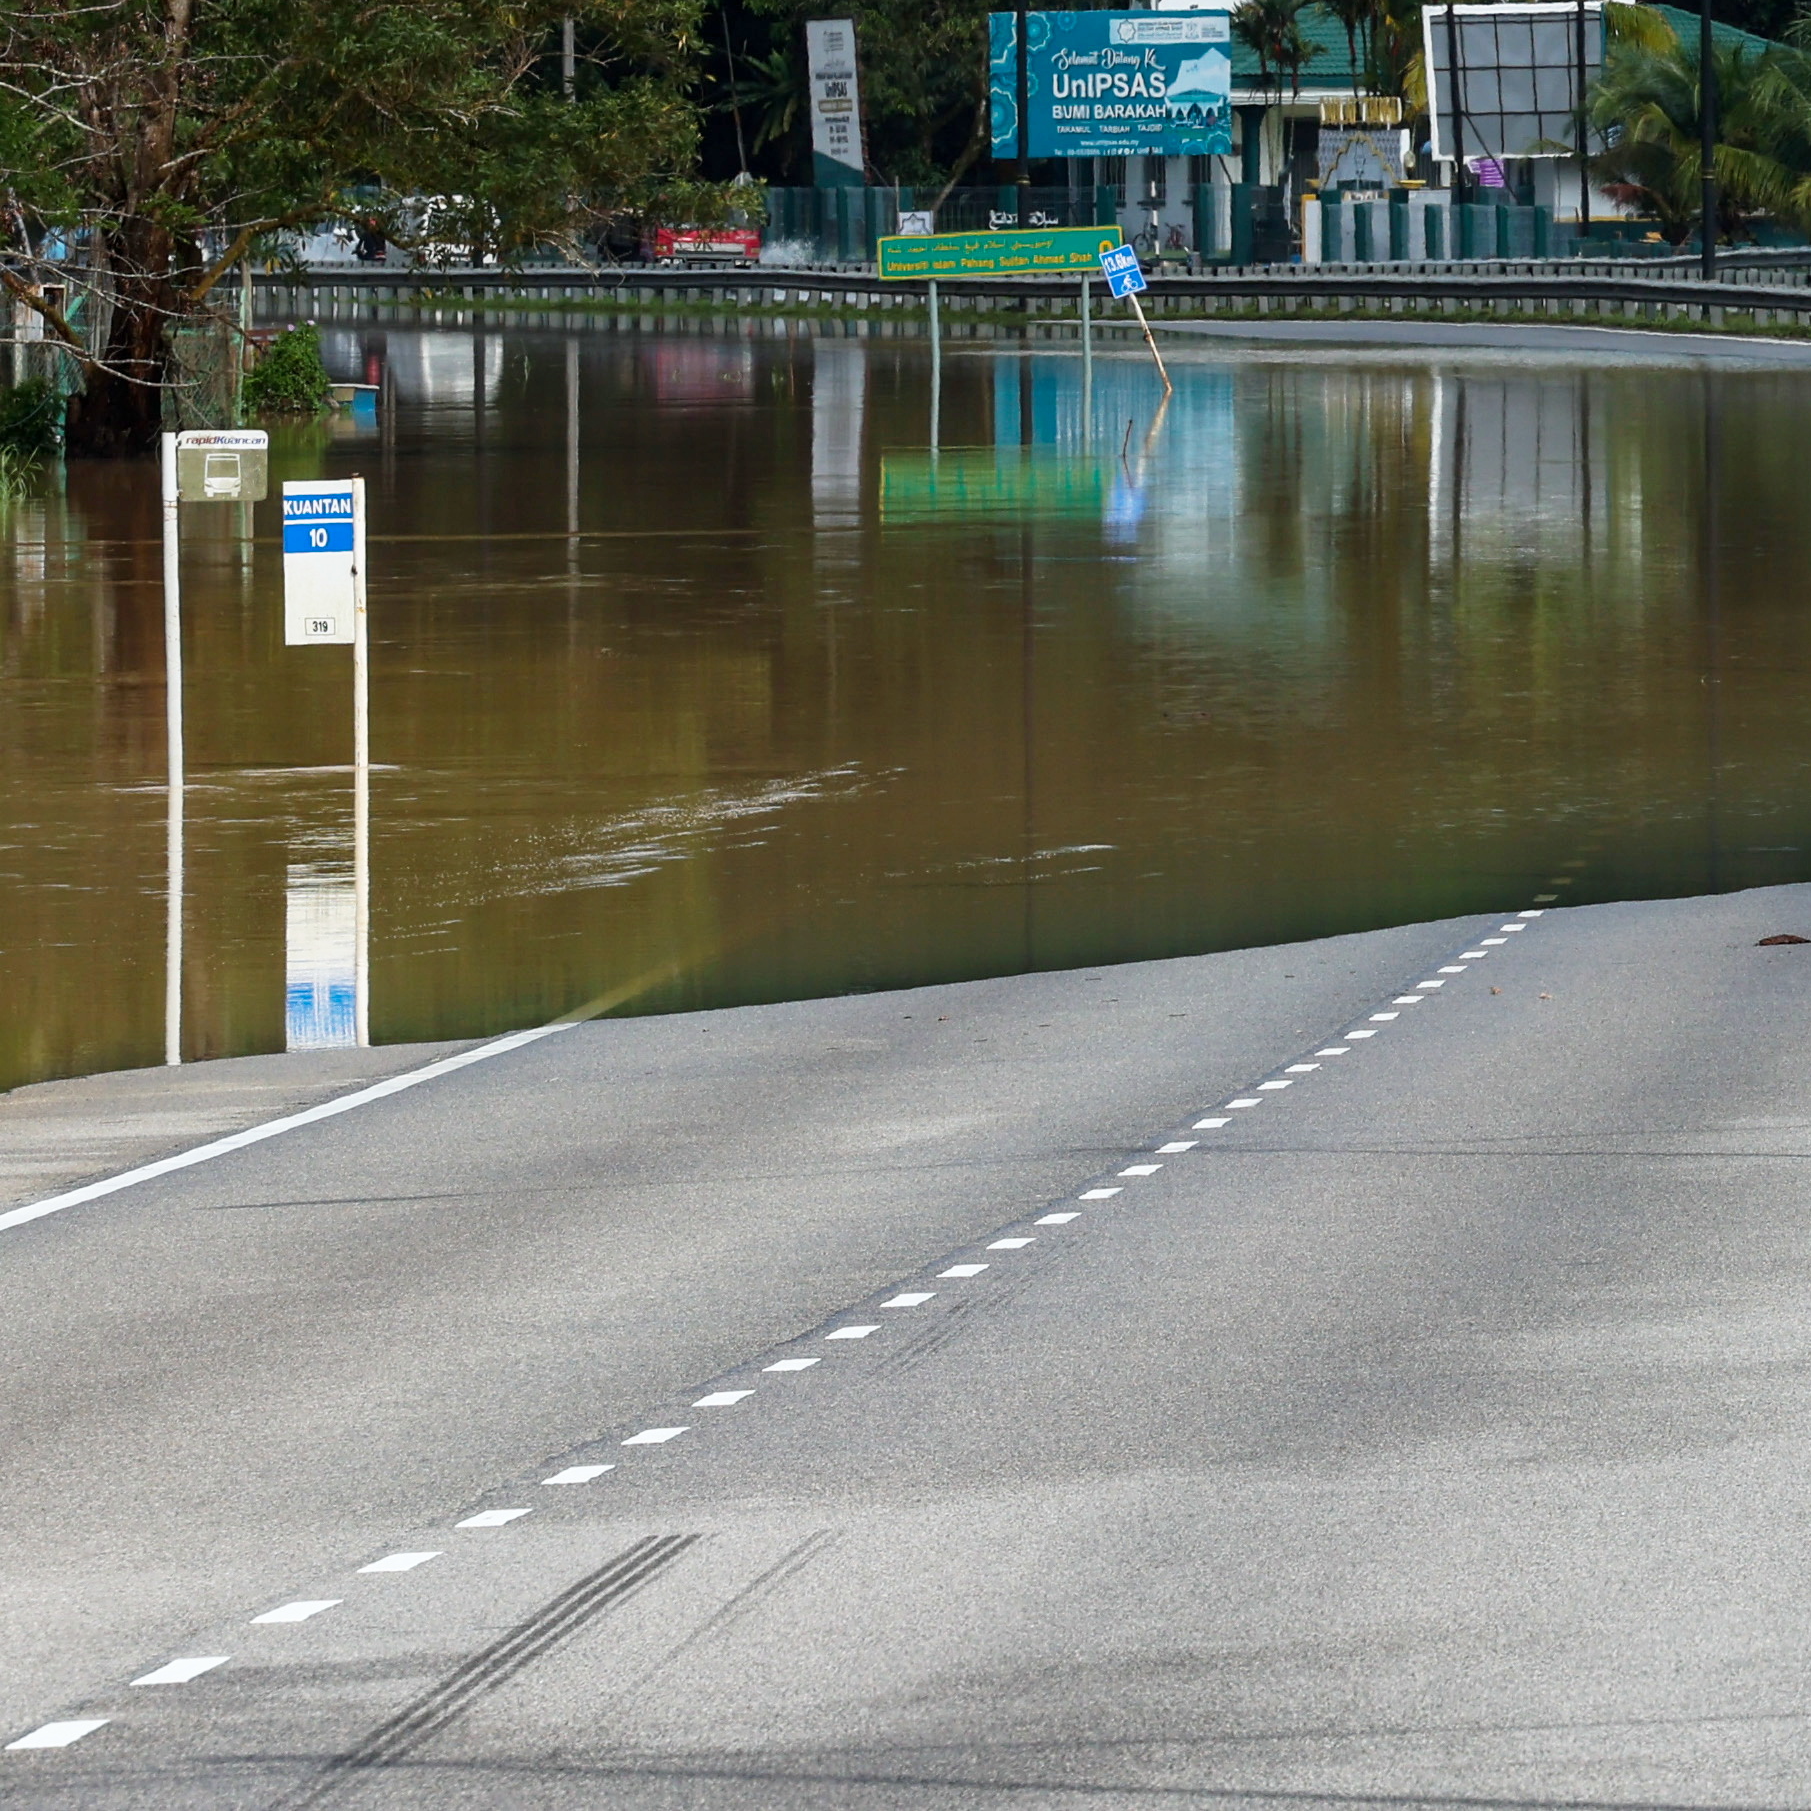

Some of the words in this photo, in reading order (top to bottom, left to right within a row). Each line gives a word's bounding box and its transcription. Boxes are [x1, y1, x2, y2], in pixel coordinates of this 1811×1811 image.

[1051, 48, 1099, 70] Selamat
[1101, 48, 1141, 70] Datang
[1143, 47, 1166, 70] Ke
[1052, 72, 1167, 99] UnIPSAS
[1052, 105, 1090, 120] BUMI
[1094, 103, 1166, 119] BARAKAH
[961, 258, 994, 270] Pahang
[1000, 256, 1029, 267] Sultan
[1033, 254, 1065, 264] Ahmad
[1070, 252, 1092, 263] Shah
[1104, 255, 1137, 273] 13.6km
[186, 435, 266, 447] rapidKuantan
[283, 498, 351, 516] KUANTAN
[309, 527, 329, 548] 10
[312, 620, 328, 632] 319
